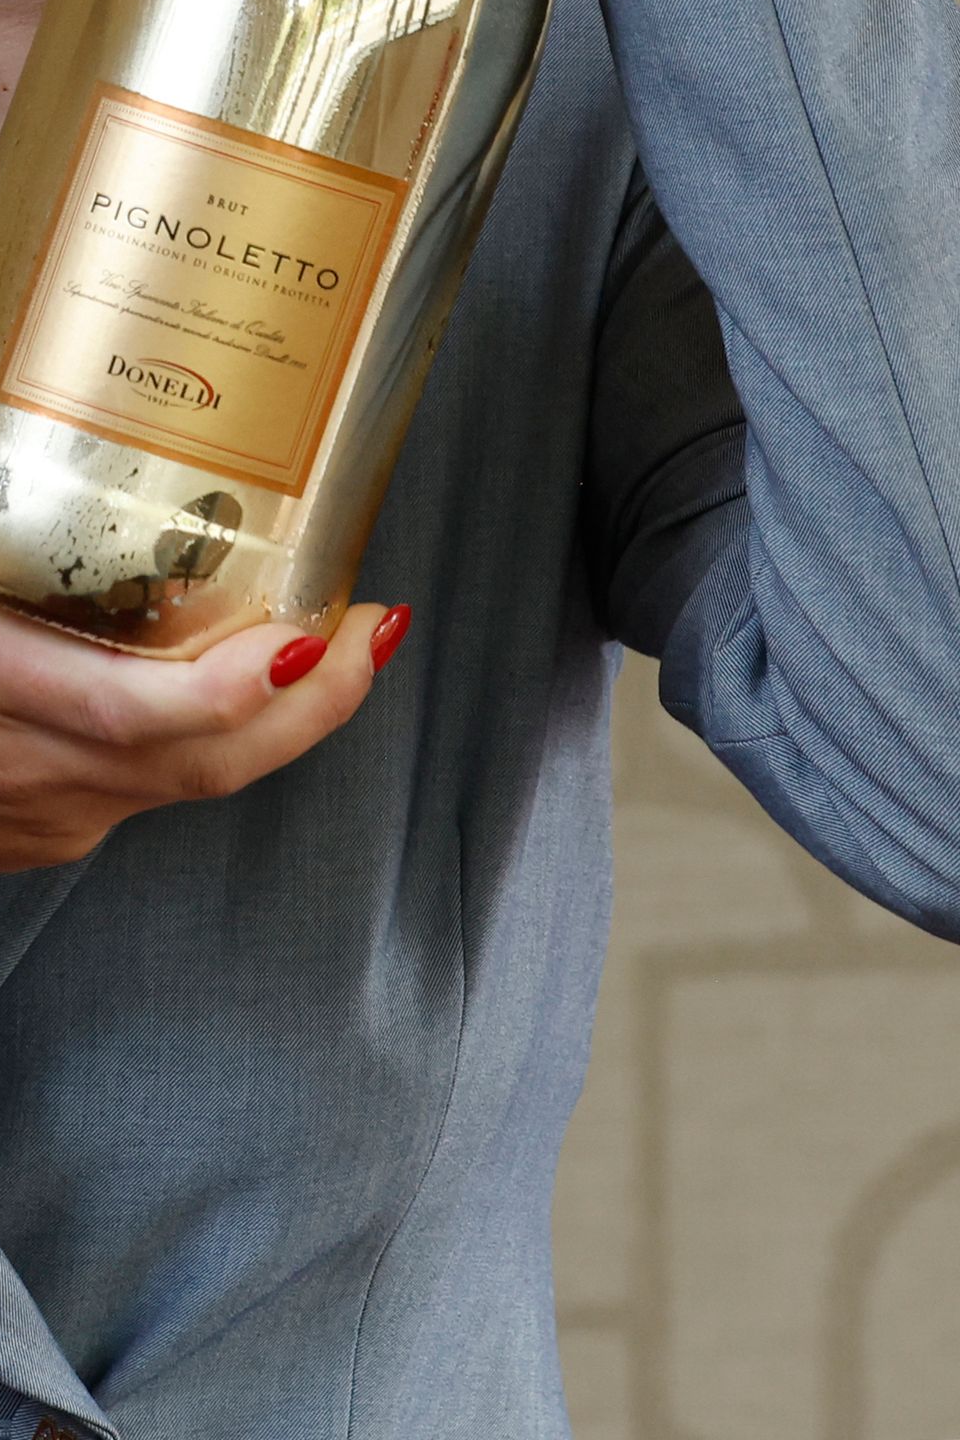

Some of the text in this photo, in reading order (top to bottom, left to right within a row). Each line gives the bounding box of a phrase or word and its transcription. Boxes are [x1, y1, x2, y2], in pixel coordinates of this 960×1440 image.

[207, 194, 248, 216] BRUT
[84, 221, 330, 308] DENOMINAZIONE DI ORIGINE PROTETTA
[90, 192, 339, 290] PIGNOLETTO
[108, 355, 222, 410] DONELLI
